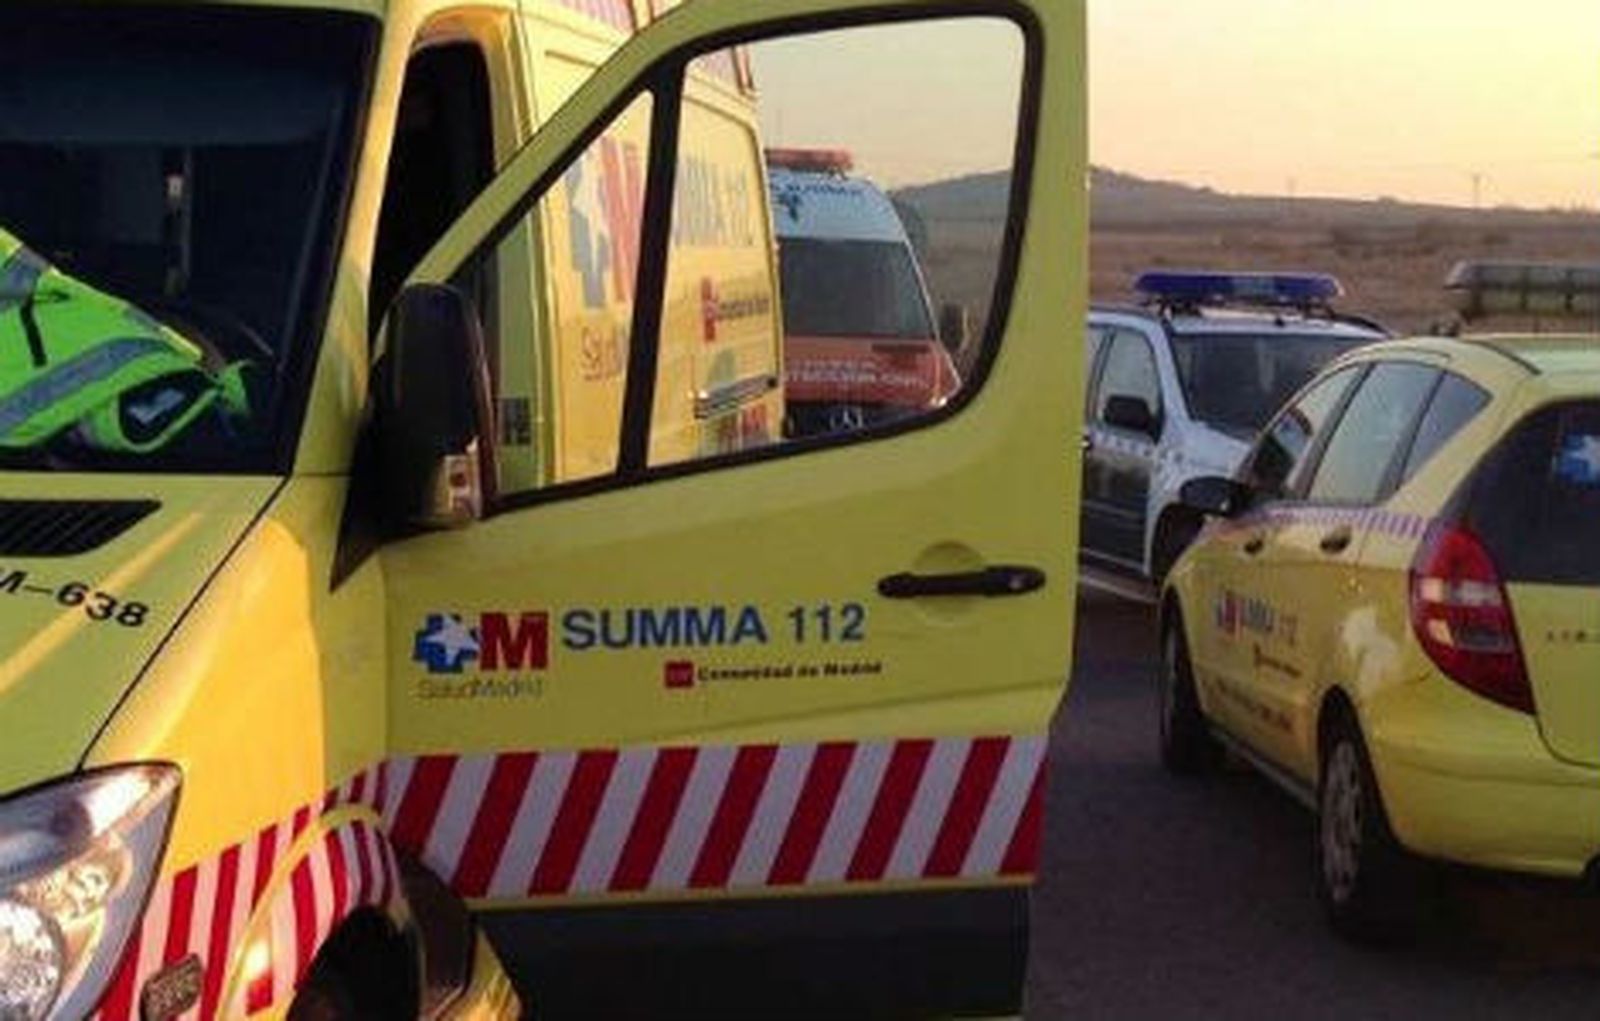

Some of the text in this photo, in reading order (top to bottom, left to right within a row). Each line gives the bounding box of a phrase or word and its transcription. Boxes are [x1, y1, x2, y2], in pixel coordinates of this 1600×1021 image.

[480, 610, 549, 671] M
[561, 602, 865, 650] SUMMA 112
